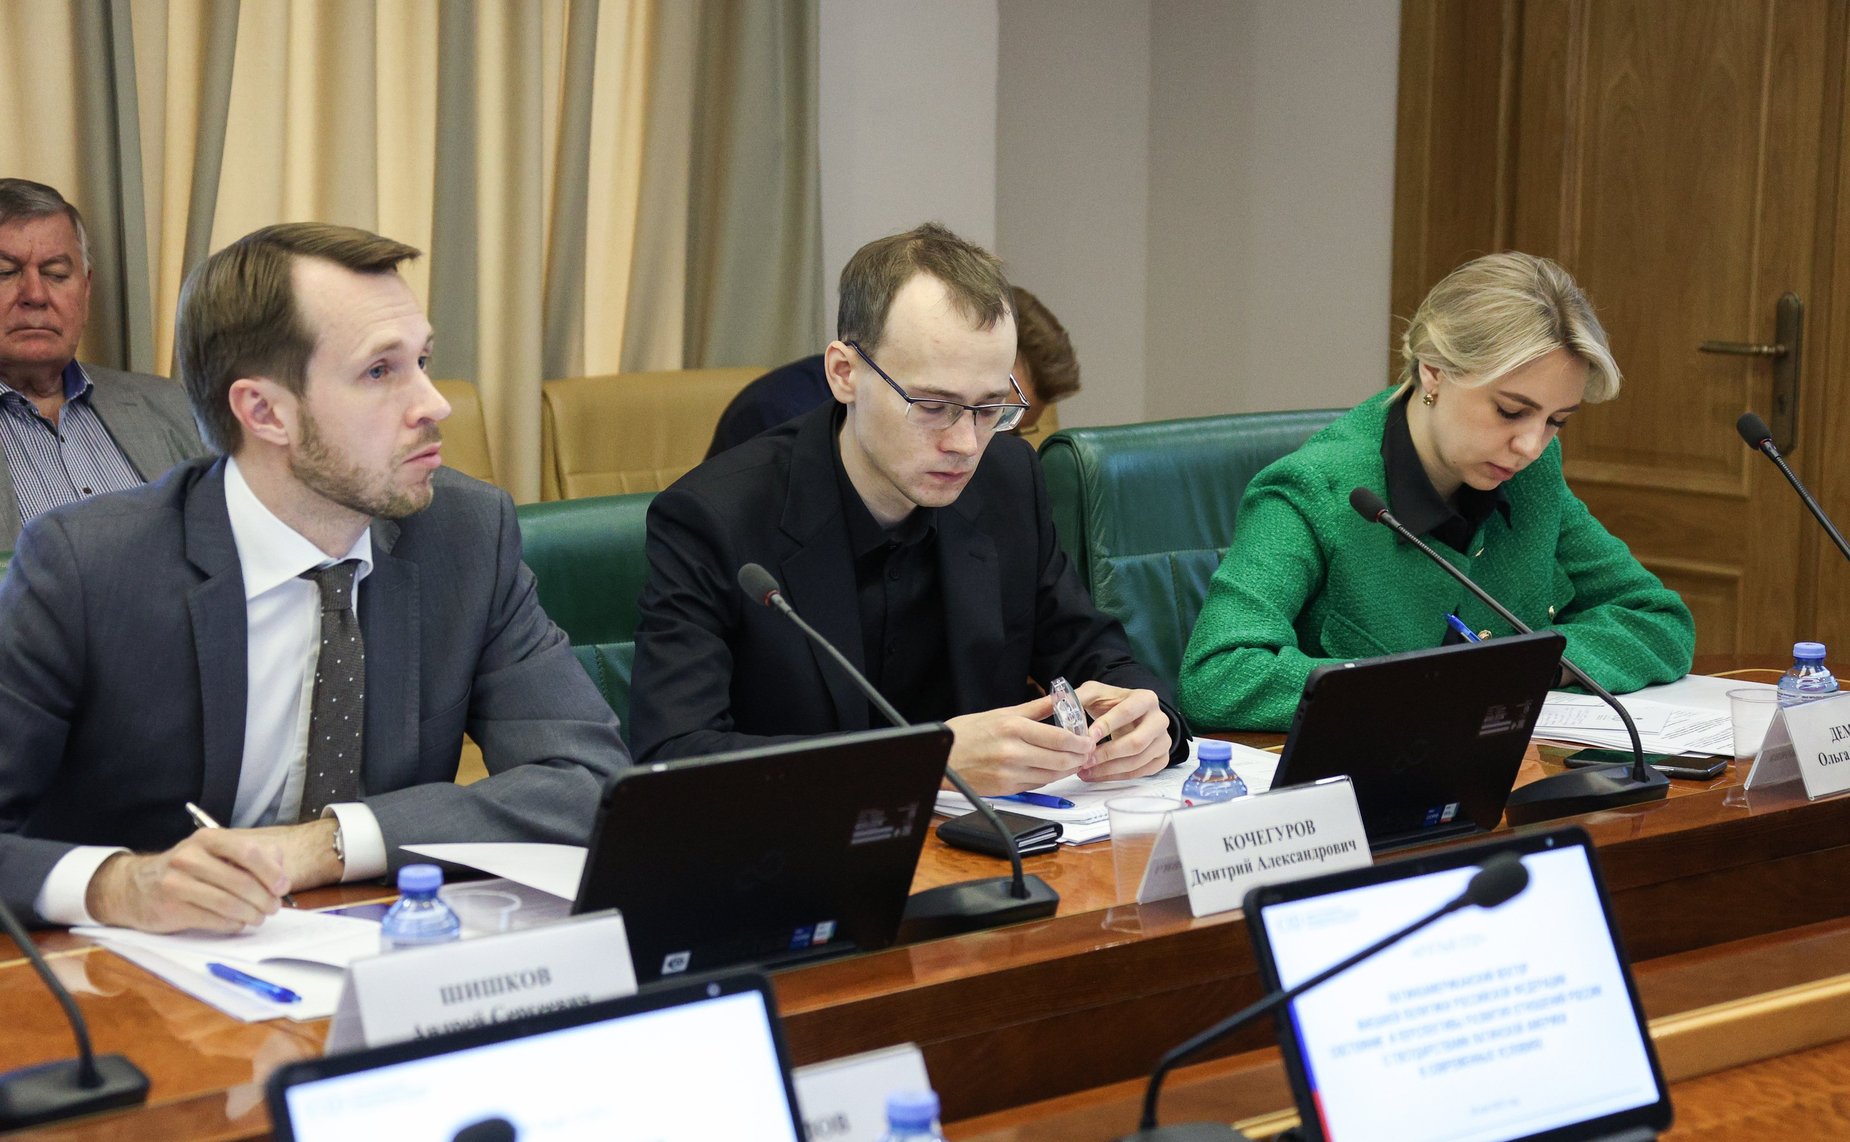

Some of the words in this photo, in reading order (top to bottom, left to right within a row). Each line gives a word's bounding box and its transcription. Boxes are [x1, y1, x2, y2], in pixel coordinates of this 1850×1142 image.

[1818, 750, 1850, 767] Ольга
[1222, 819, 1316, 853] КОЧЕГУРОВ
[1191, 856, 1253, 887] Дмитрий
[1257, 839, 1357, 872] Александрович
[440, 967, 553, 1005] ШИШКОВ
